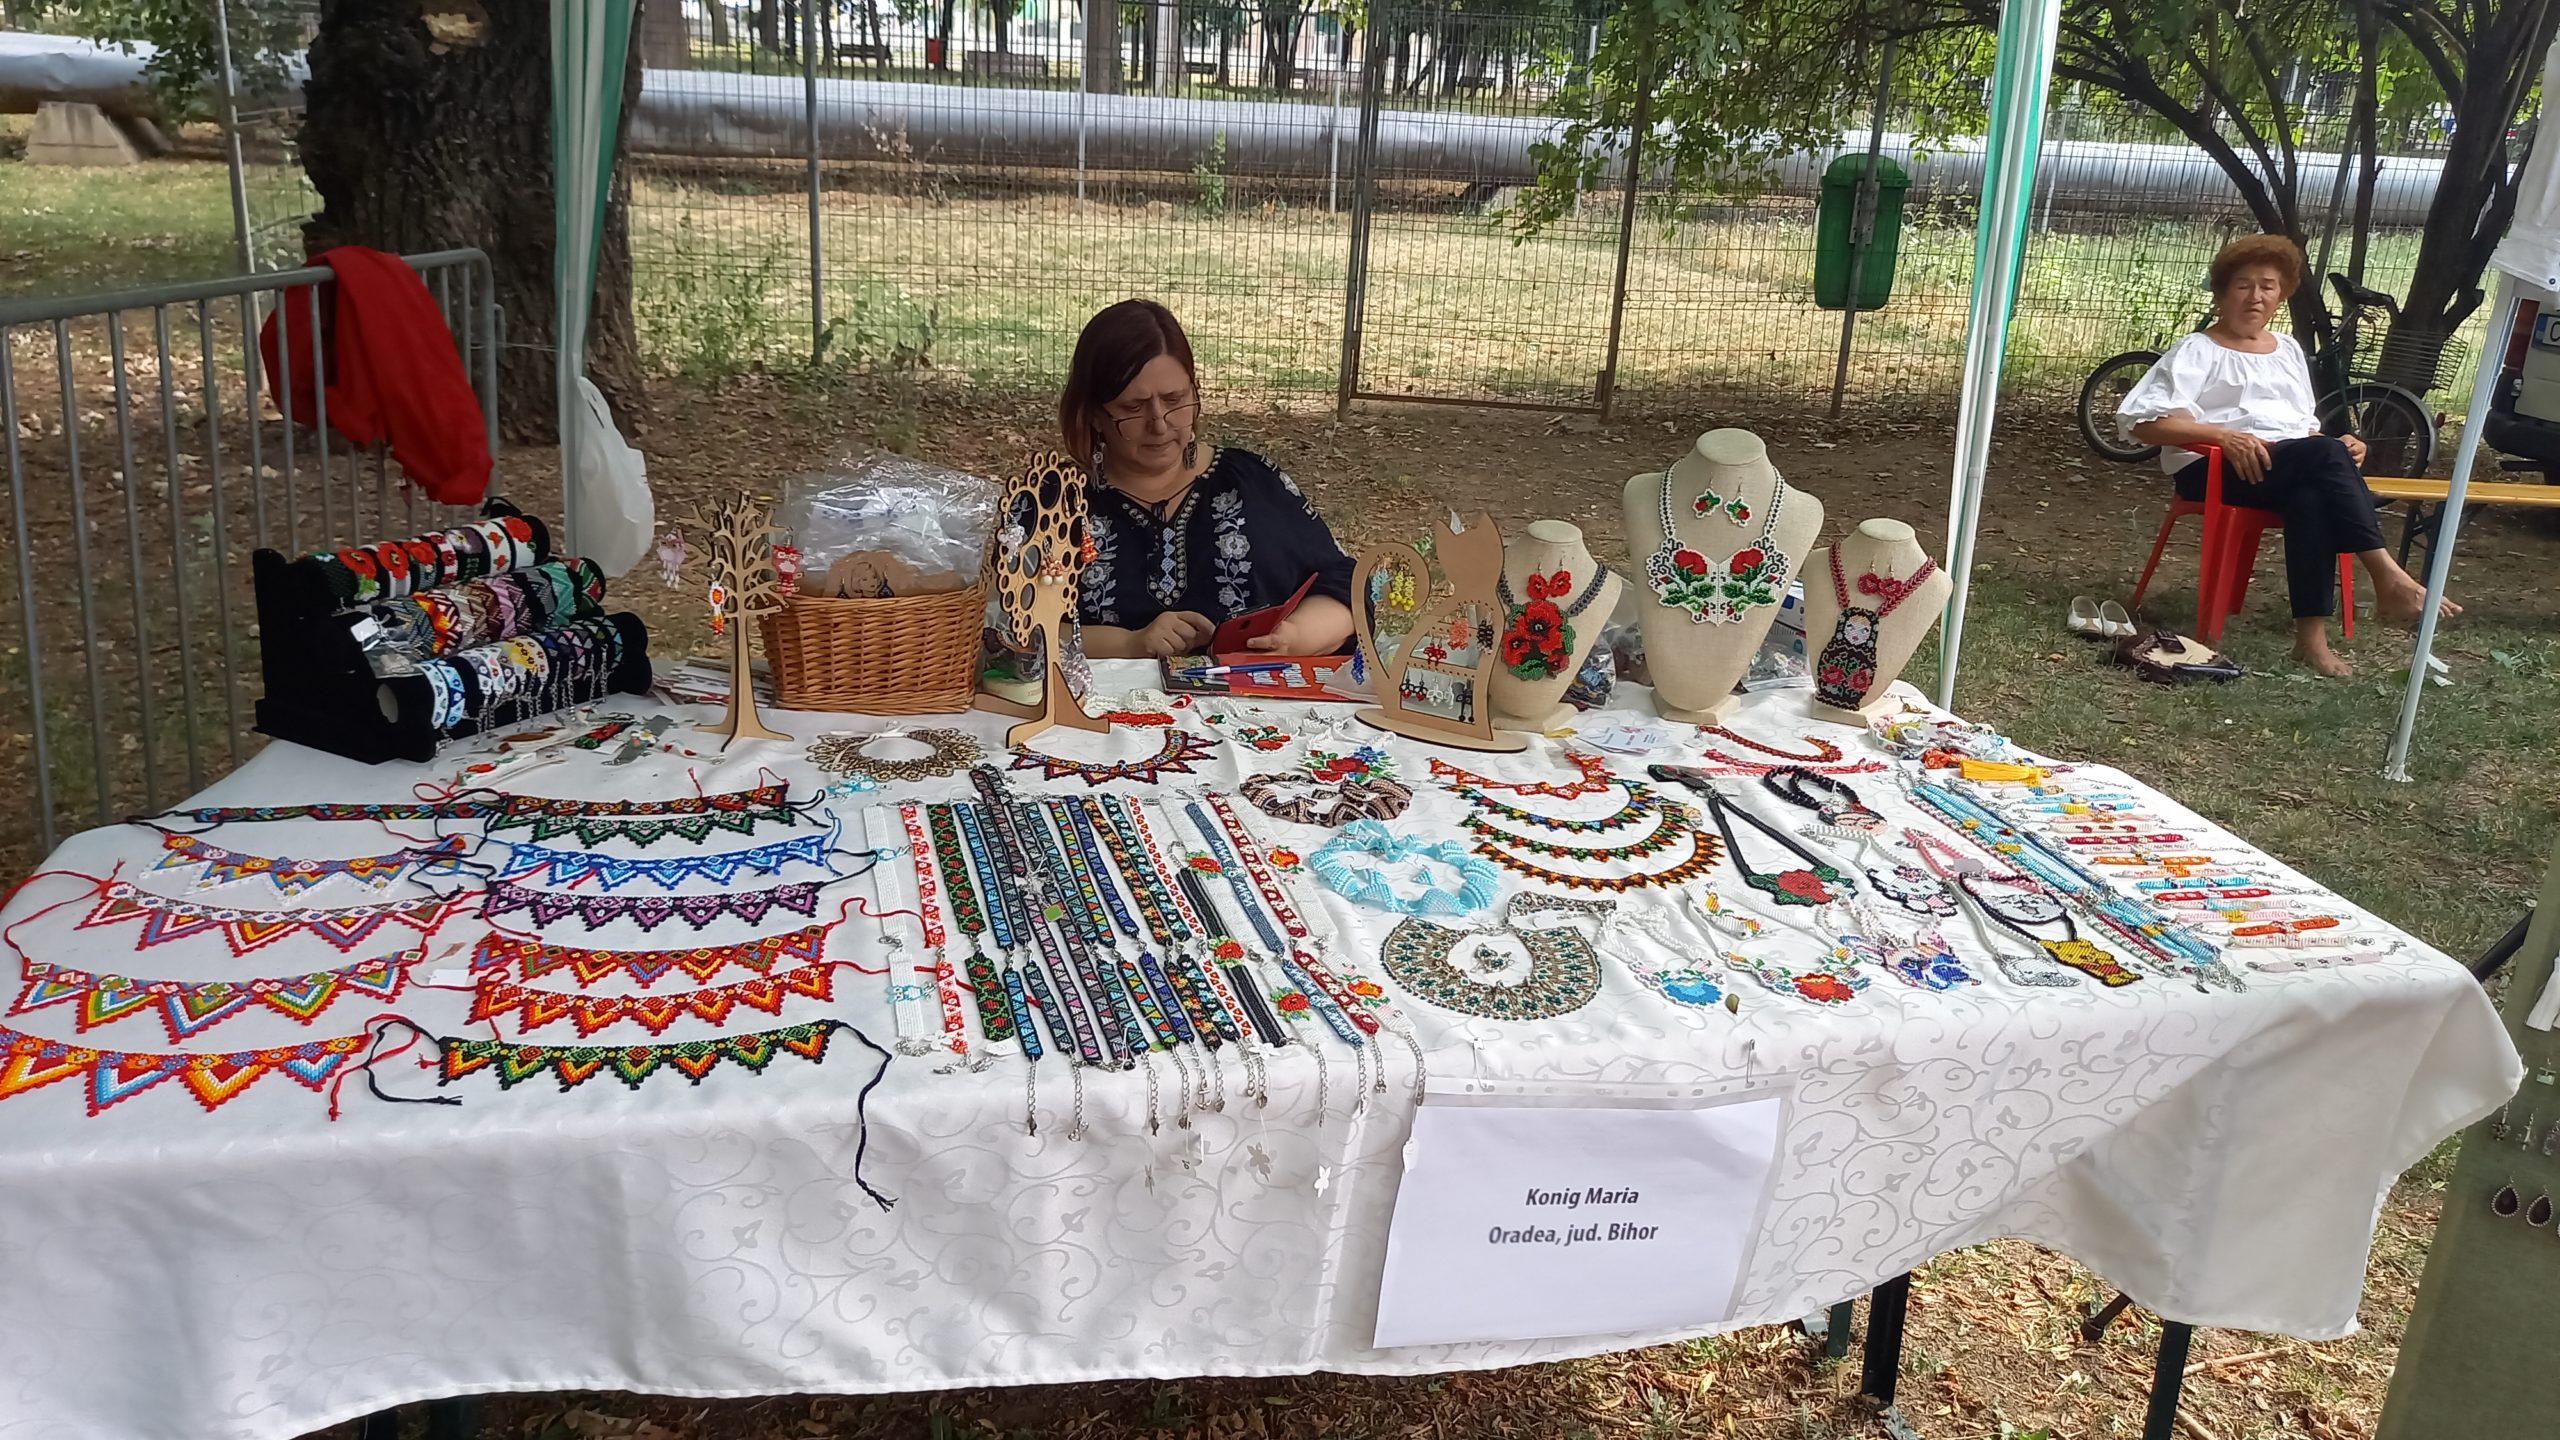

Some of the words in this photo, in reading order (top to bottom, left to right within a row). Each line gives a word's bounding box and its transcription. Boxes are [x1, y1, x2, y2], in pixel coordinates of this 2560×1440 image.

[1525, 1187, 1582, 1210] Konig
[1584, 1186, 1640, 1205] Maria
[1488, 1224, 1562, 1246] Oradea,
[1563, 1223, 1602, 1247] jud.
[1607, 1222, 1659, 1241] Bihor
